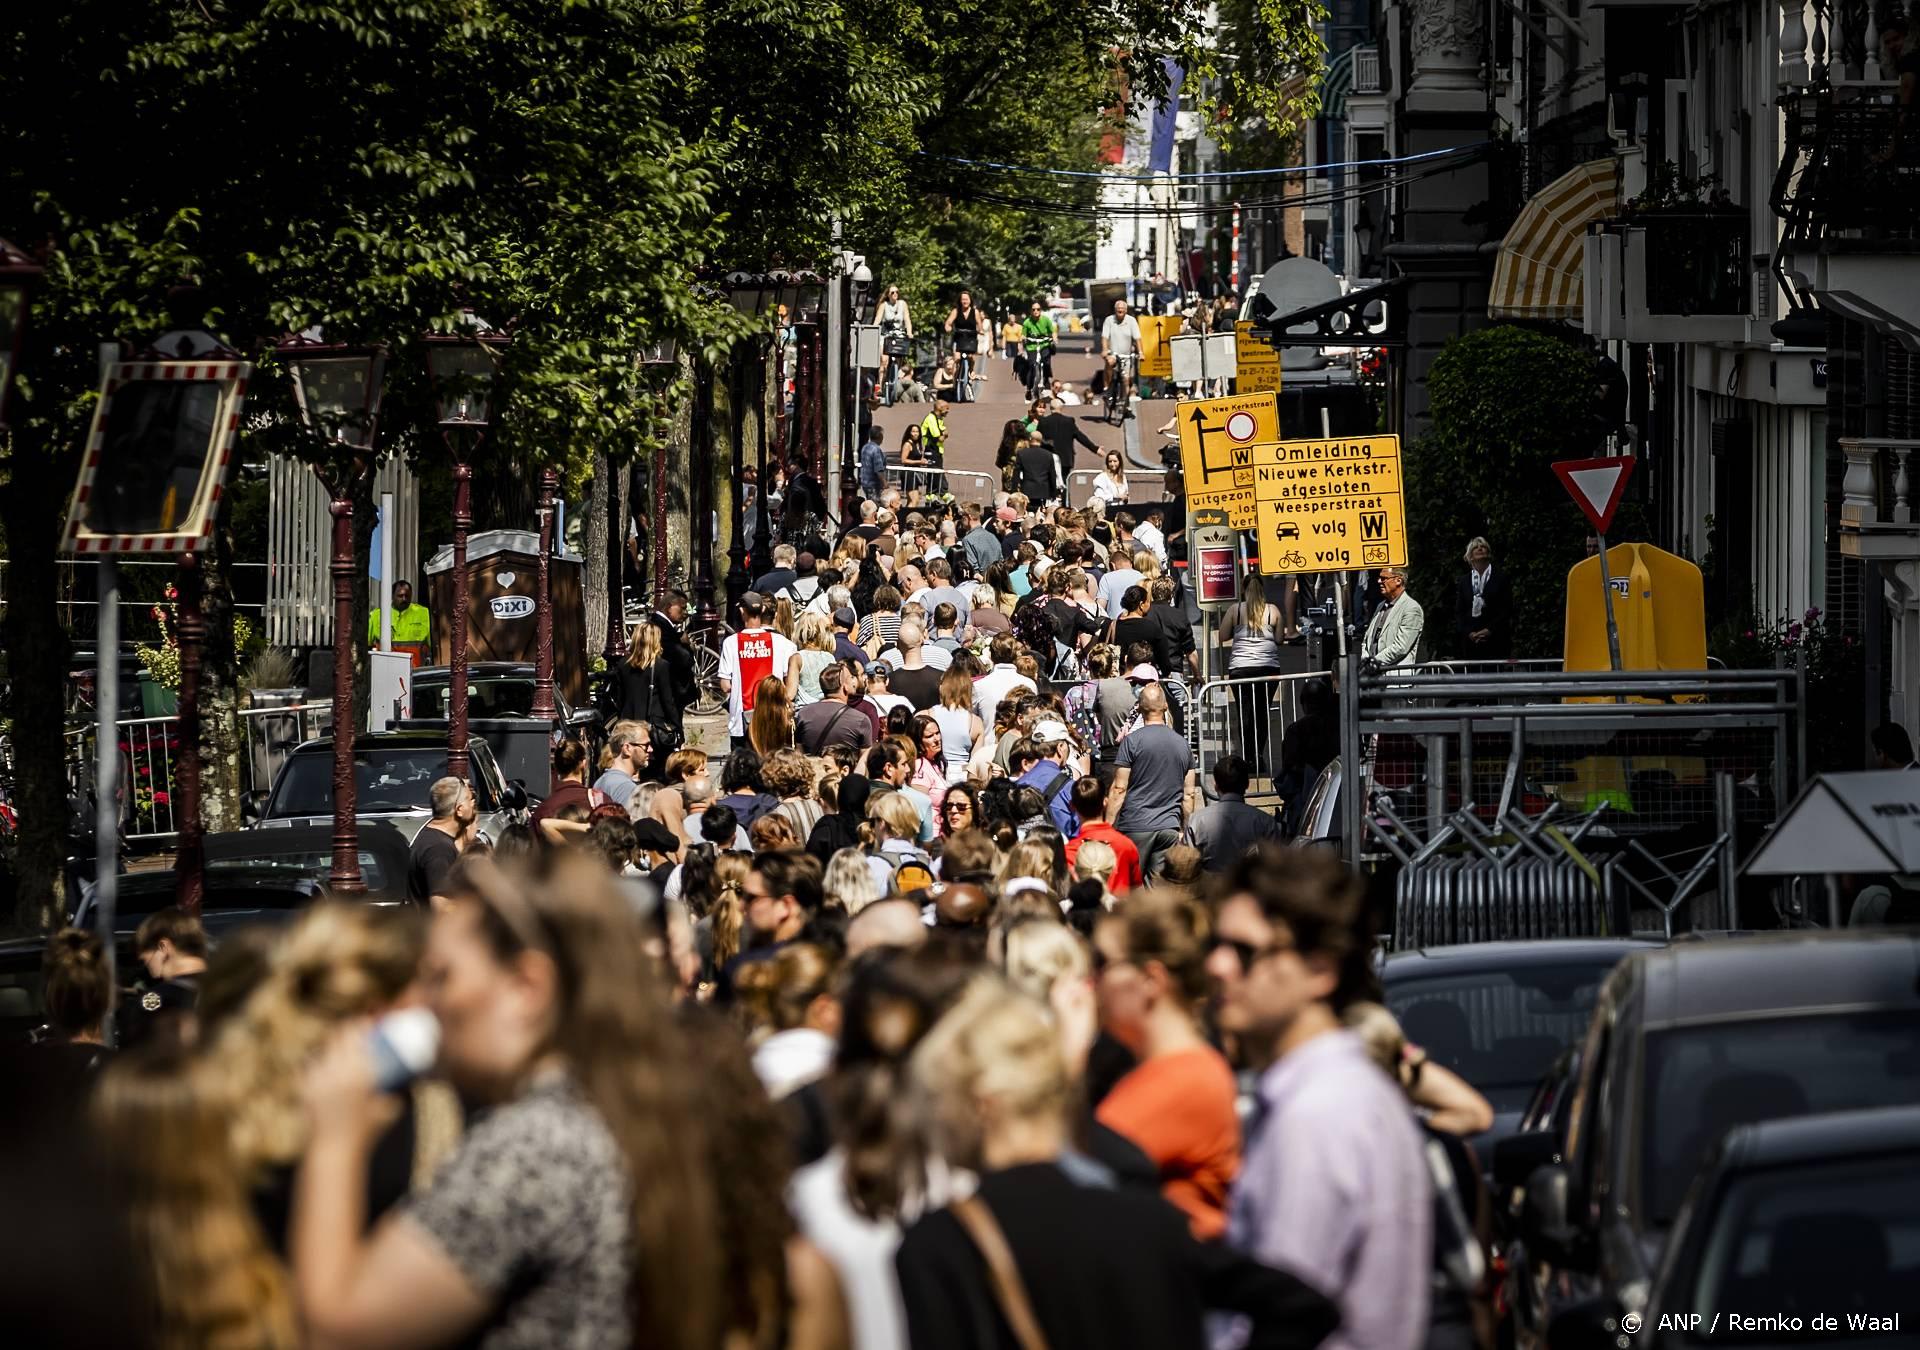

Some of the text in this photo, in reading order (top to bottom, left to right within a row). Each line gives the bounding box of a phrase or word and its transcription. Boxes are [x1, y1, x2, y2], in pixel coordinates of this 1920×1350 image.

[1212, 400, 1273, 413] Nwe Kerkstraat
[1234, 450, 1249, 464] W
[1275, 443, 1371, 460] Omleiding
[1259, 461, 1392, 481] Nieuwe Kerkstr.
[1193, 491, 1252, 505] uitgezon
[1282, 480, 1371, 499] afgesloten
[1274, 496, 1382, 514] Weesperstraat
[1312, 514, 1384, 539] volg W
[1315, 547, 1350, 566] volg
